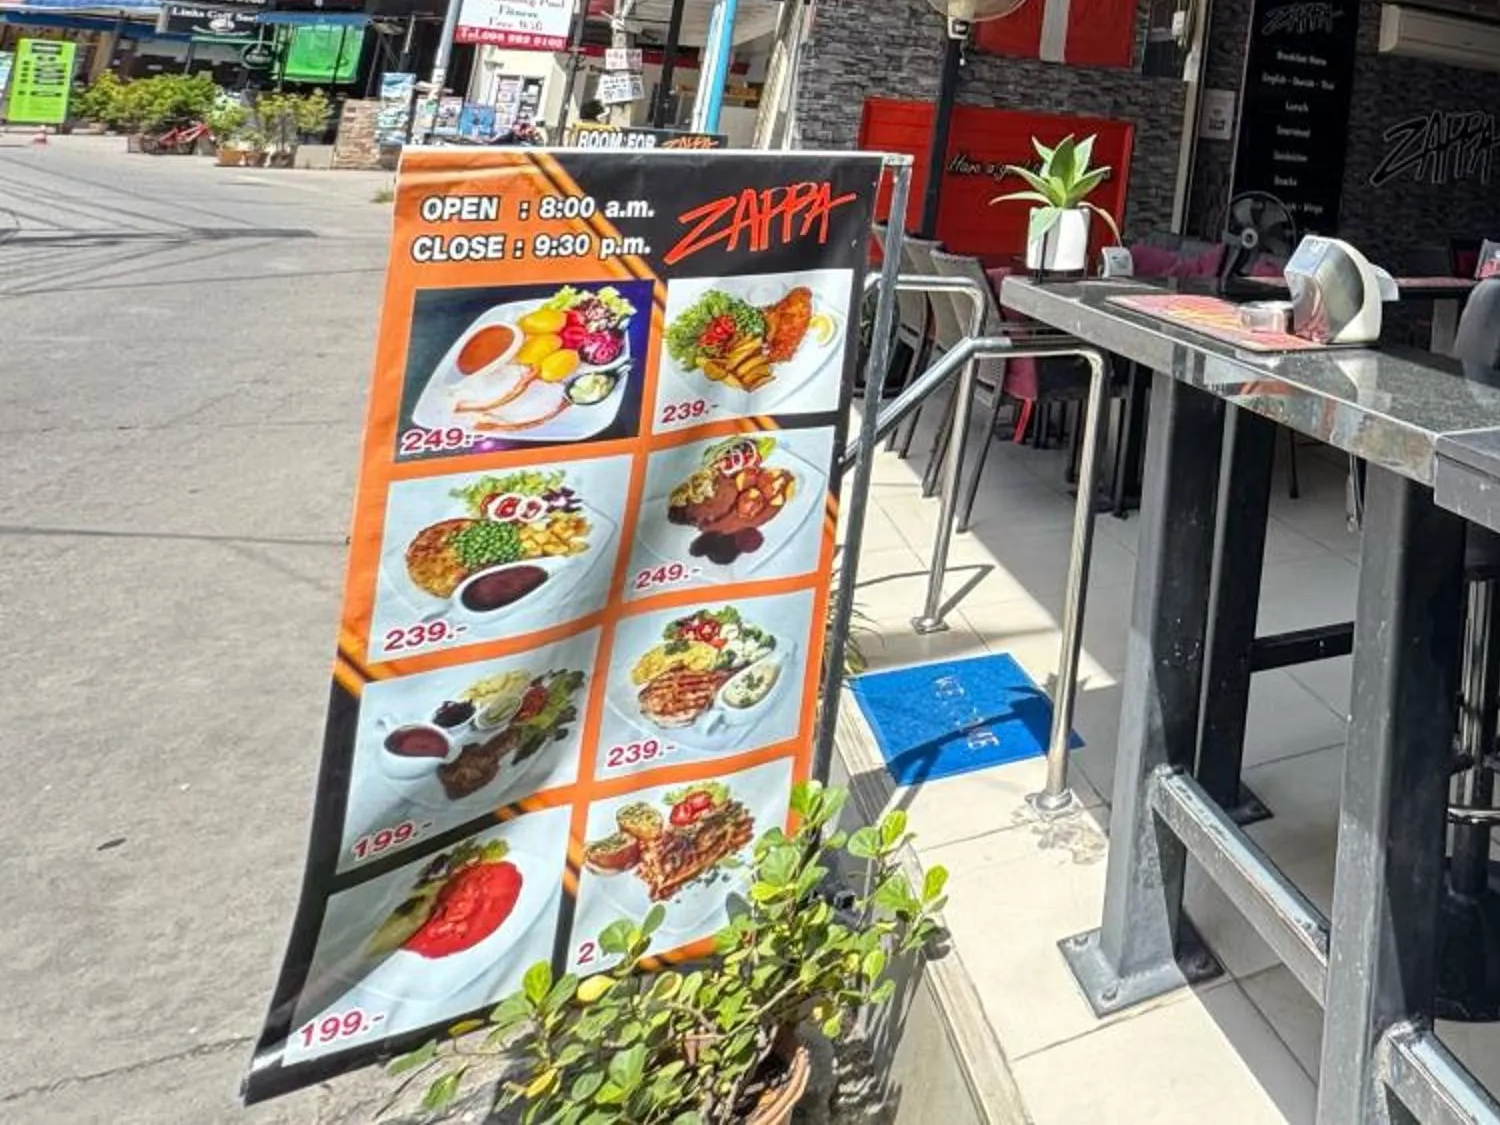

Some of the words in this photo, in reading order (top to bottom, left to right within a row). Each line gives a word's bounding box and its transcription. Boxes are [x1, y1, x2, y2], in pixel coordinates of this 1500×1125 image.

[578, 130, 623, 148] ROOM
[627, 132, 656, 148] FOR
[421, 196, 498, 221] OPEN
[538, 196, 595, 218] 8:00
[605, 199, 655, 218] a.m.
[663, 182, 857, 266] ZAPPA
[412, 236, 504, 262] CLOSE
[533, 234, 589, 257] 9:30
[599, 237, 651, 261] p.m.
[661, 400, 719, 424] 239.-
[634, 564, 701, 589] 249.-
[384, 622, 467, 652] 239.-
[607, 740, 676, 767] 239.-
[353, 821, 433, 860] 199.-
[300, 1010, 385, 1047] 199.-
